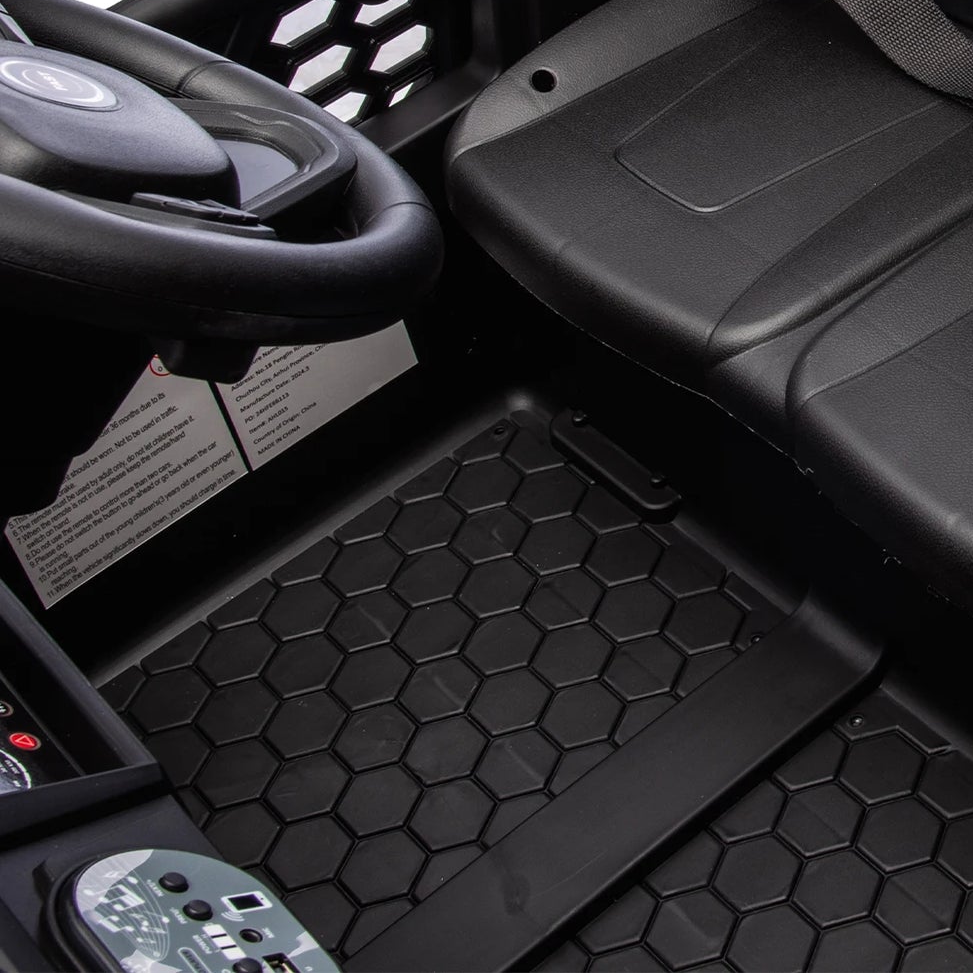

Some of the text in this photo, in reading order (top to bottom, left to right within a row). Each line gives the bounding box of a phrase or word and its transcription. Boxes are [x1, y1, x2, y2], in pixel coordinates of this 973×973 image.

[231, 373, 256, 391] Address:
[240, 388, 275, 413] Manufacture
[291, 366, 310, 381] 2024.3
[273, 365, 290, 378] Anhui
[118, 409, 140, 426] months
[139, 401, 151, 412] due
[253, 429, 275, 445] Country
[301, 402, 317, 414] China
[70, 461, 91, 478] should
[114, 438, 127, 449] Not
[140, 419, 156, 433] used
[257, 441, 275, 455] MADE
[282, 425, 301, 439] CHINA
[30, 508, 52, 526] remote
[51, 498, 68, 512] must
[75, 482, 91, 496] used
[98, 468, 113, 482] adult
[134, 447, 145, 458] not
[152, 428, 175, 446] children
[173, 419, 189, 432] have
[40, 520, 51, 530] the
[50, 506, 72, 523] remote
[77, 495, 89, 505] not
[106, 471, 127, 488] please
[125, 461, 141, 473] keep
[140, 455, 151, 464] the
[92, 517, 103, 527] the
[102, 505, 122, 520] button
[168, 464, 183, 477] back
[182, 454, 199, 467] when
[50, 534, 62, 544] use
[61, 527, 73, 537] the
[72, 513, 93, 530] remote
[99, 495, 120, 512] control
[119, 486, 135, 499] more
[133, 477, 148, 489] than
[147, 470, 159, 480] two
[73, 547, 90, 561] parts
[104, 530, 115, 539] the
[115, 518, 134, 534] young
[164, 486, 181, 501] years
[196, 466, 210, 479] even
[168, 507, 180, 519] you
[179, 493, 199, 510] should
[198, 482, 217, 497] charge
